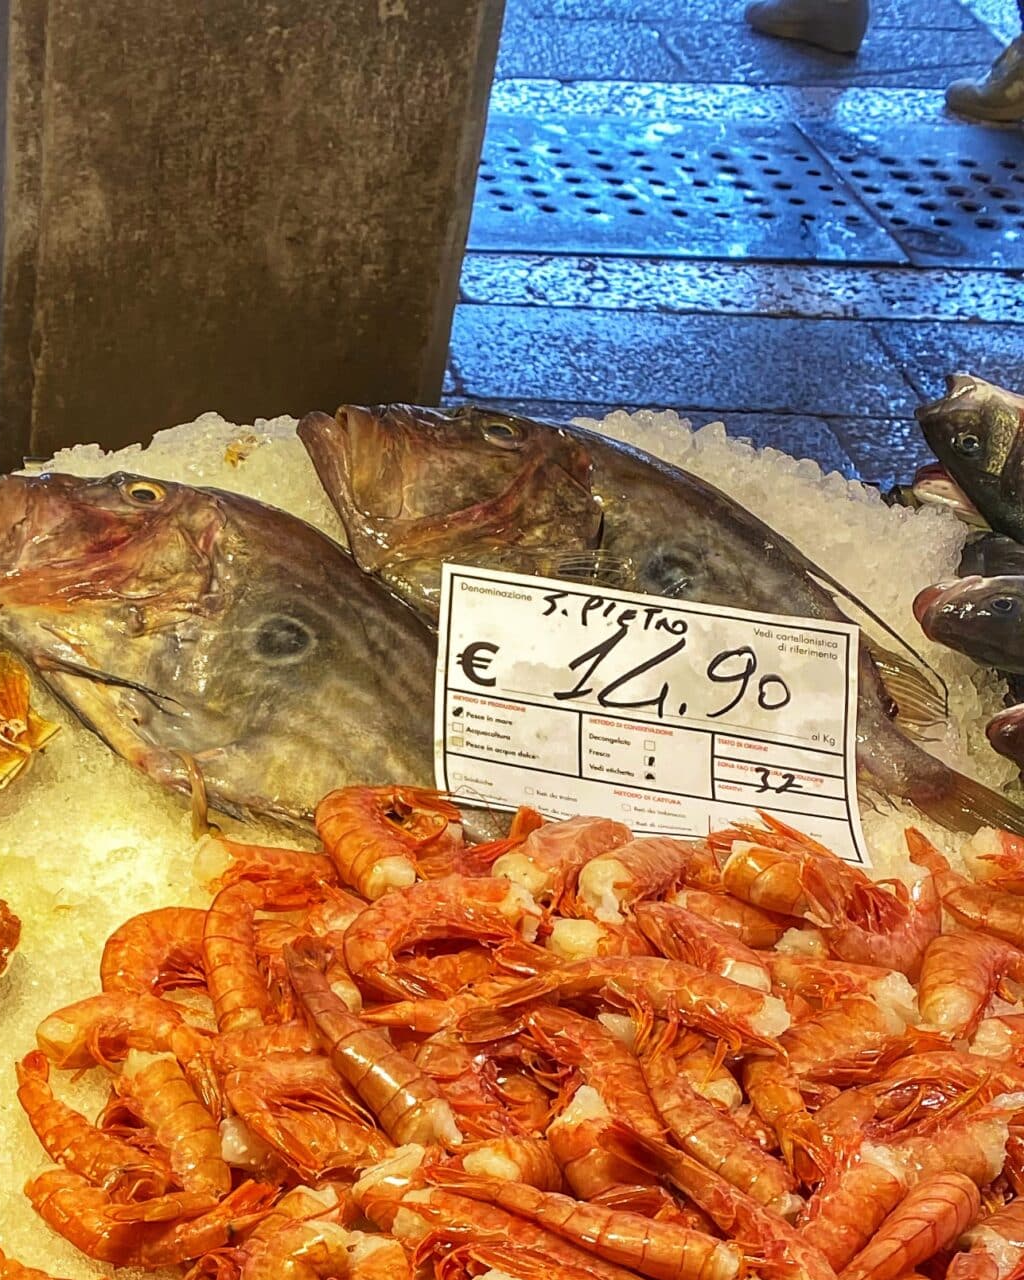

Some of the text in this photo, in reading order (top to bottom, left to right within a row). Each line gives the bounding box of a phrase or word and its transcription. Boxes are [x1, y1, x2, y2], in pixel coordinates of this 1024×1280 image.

[460, 582, 533, 601] Denominazione
[753, 628, 838, 649] Vedi cartellonistica
[778, 643, 838, 660] di riferimento
[456, 625, 791, 718] € 14.90
[811, 733, 836, 746] al Kg
